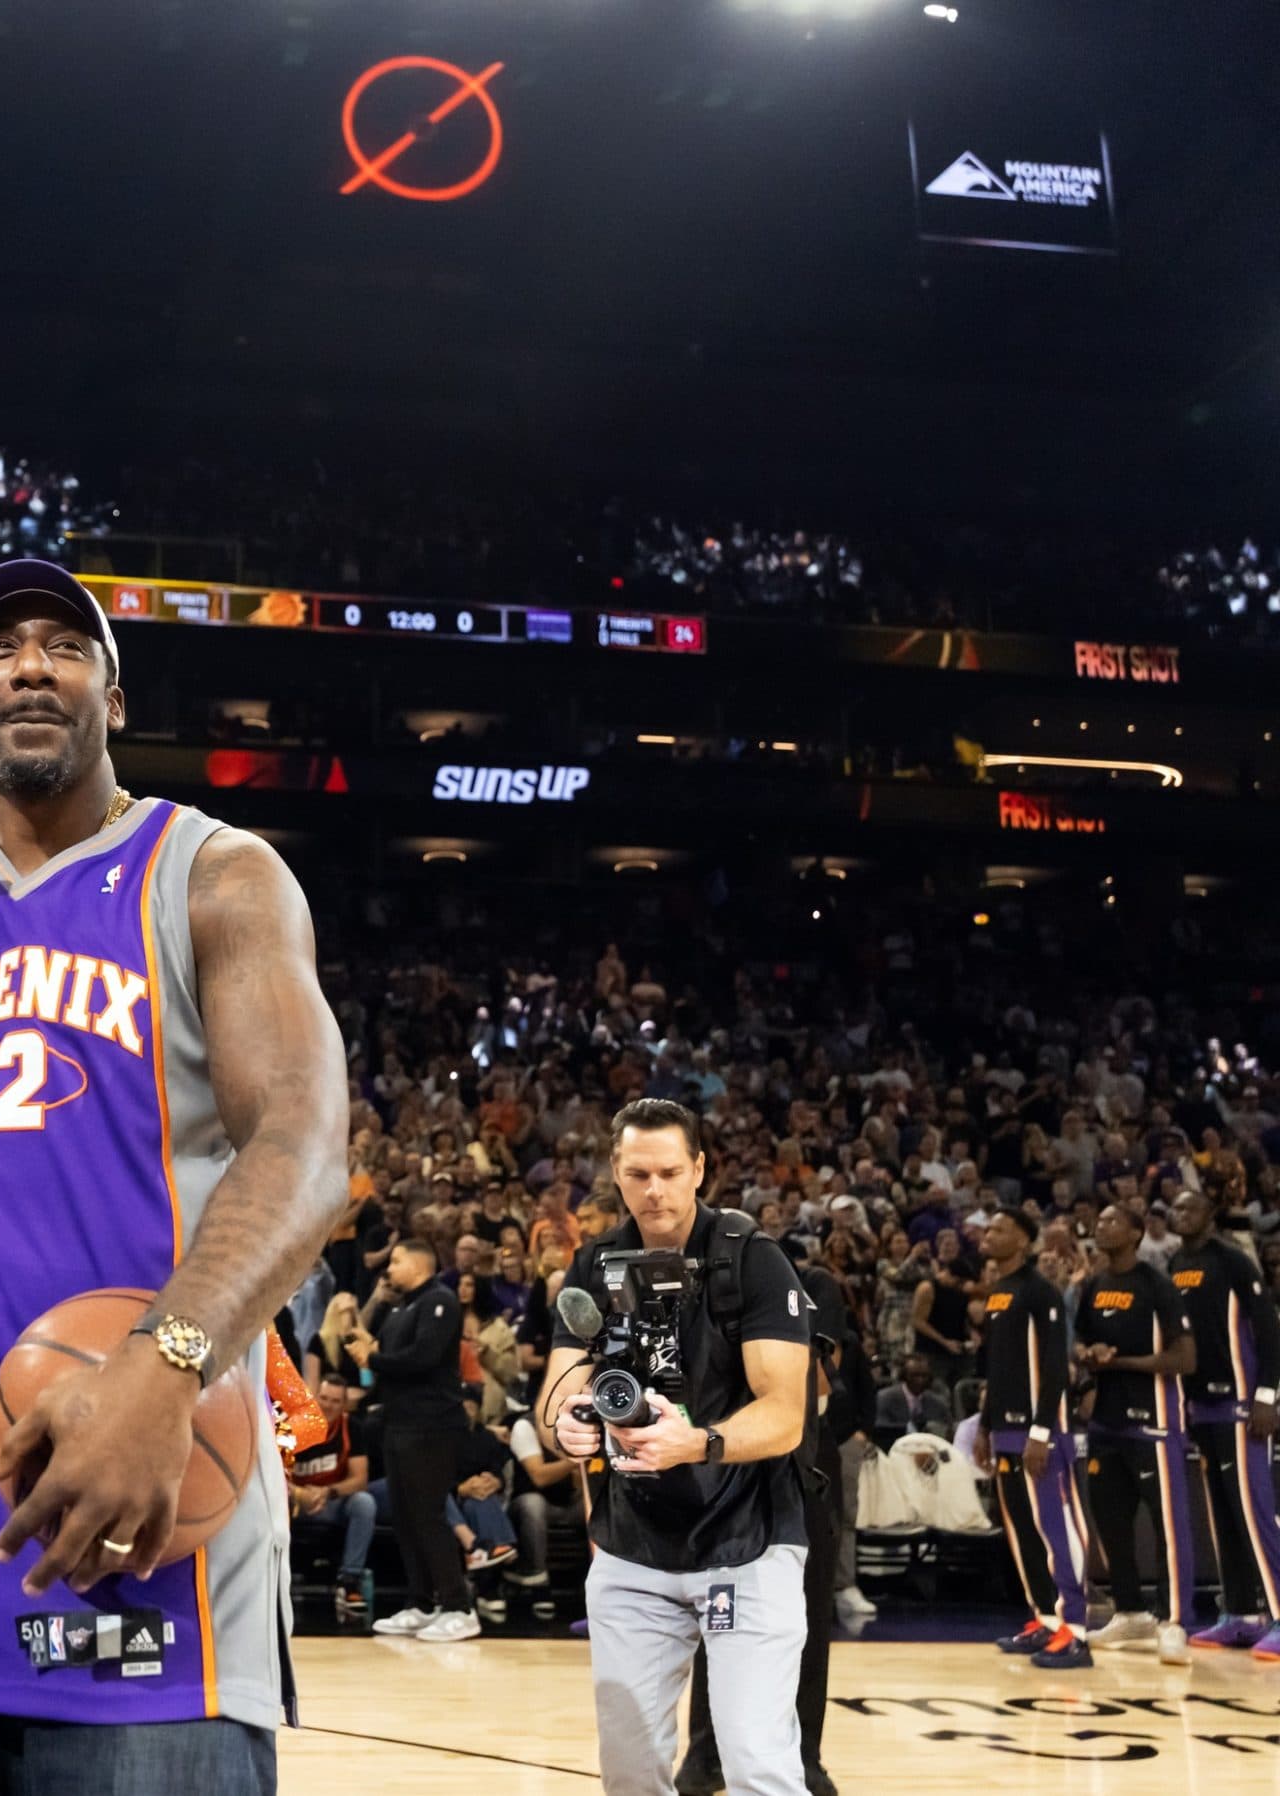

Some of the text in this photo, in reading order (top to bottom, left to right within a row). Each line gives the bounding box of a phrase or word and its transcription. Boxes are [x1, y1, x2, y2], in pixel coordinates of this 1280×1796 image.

[1004, 160, 1101, 185] MOUNTAIN
[1012, 176, 1098, 200] AMERICA
[388, 610, 436, 631] 12:00
[21, 1619, 45, 1641] 50
